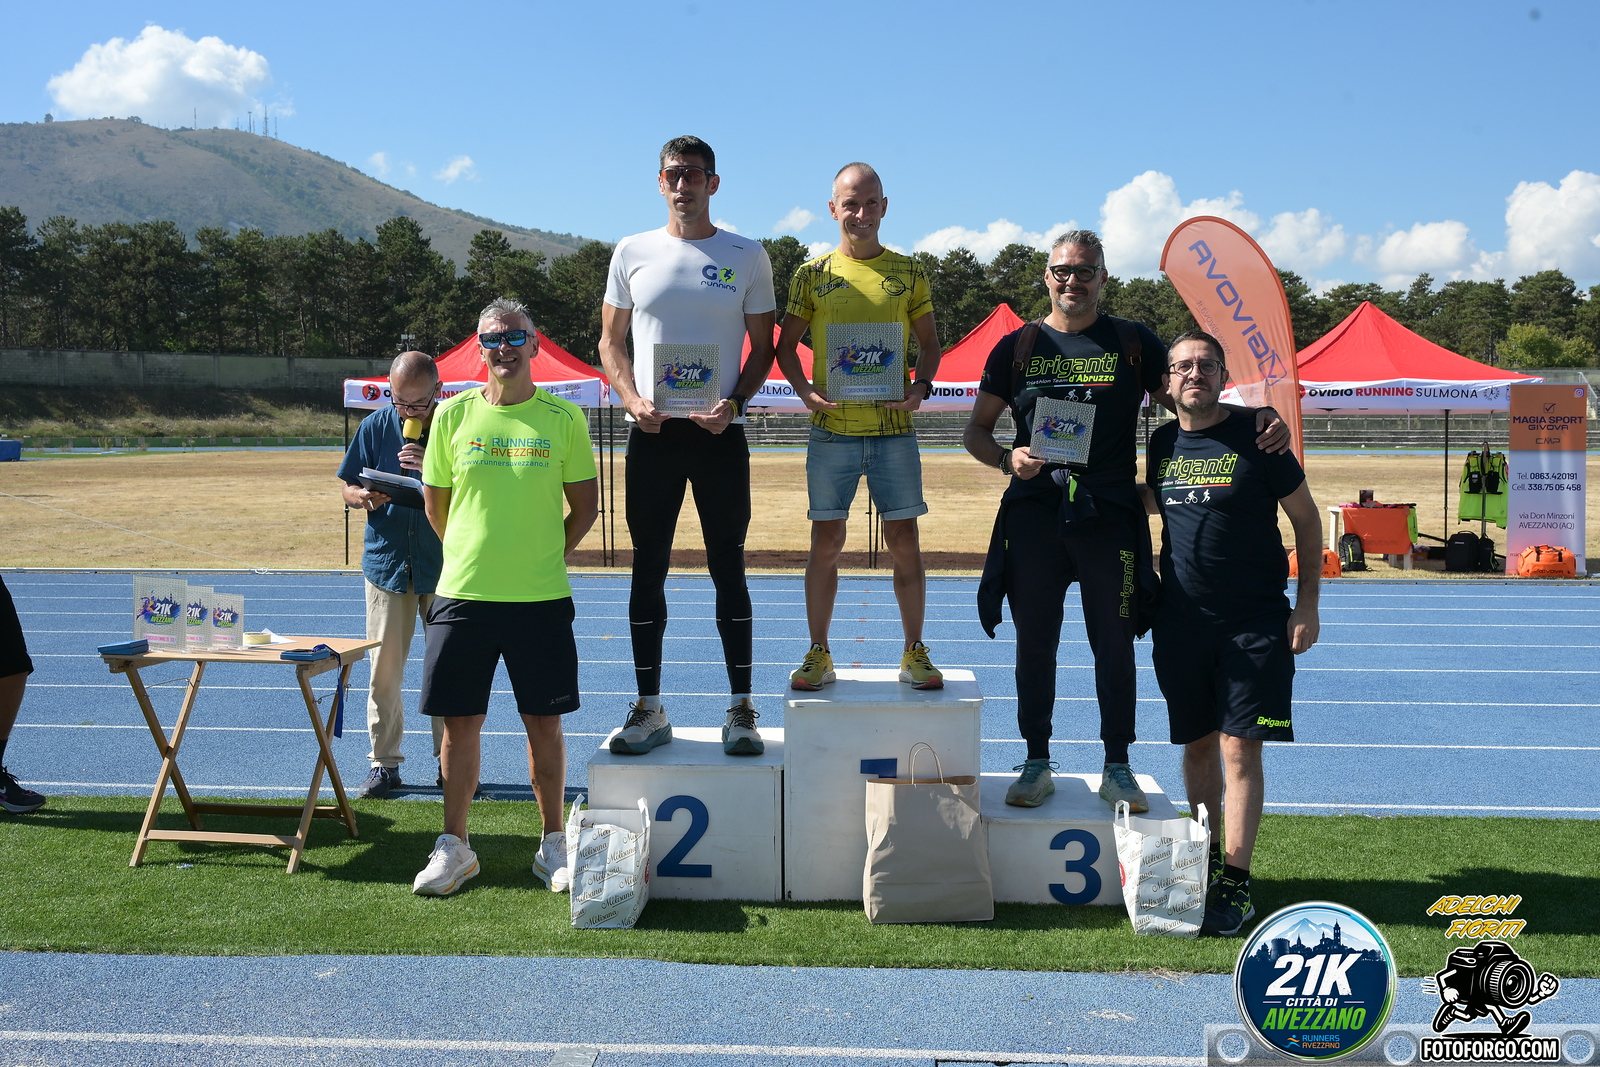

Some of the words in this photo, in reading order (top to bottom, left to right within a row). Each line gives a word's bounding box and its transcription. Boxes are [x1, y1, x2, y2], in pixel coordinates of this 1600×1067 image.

[701, 281, 737, 292] running
[856, 351, 883, 364] 21K
[1026, 353, 1118, 378] Briganti
[679, 369, 702, 379] 21K
[1069, 374, 1115, 383] d'Abruzzo
[931, 388, 964, 397] VIDIO
[1309, 388, 1353, 397] OVIDIO
[1356, 387, 1413, 396] RUNNING
[1416, 388, 1478, 398] SULMONA
[1513, 416, 1547, 424] MAGIA
[1549, 416, 1584, 424] SPORT
[1054, 421, 1077, 433] 21K
[492, 437, 551, 449] RUNNERS
[491, 447, 550, 458] AVEZZANO
[461, 459, 549, 468] www.runnersavezzano.it
[1157, 453, 1238, 480] Briganti
[1188, 477, 1232, 485] d'Abruzzo
[1119, 549, 1134, 618] Briganti
[153, 602, 172, 615] 21K
[187, 607, 201, 618] 21K
[219, 612, 233, 621] 21K
[1257, 716, 1290, 727] Briganti
[655, 795, 712, 877] 2
[1049, 829, 1102, 906] 3
